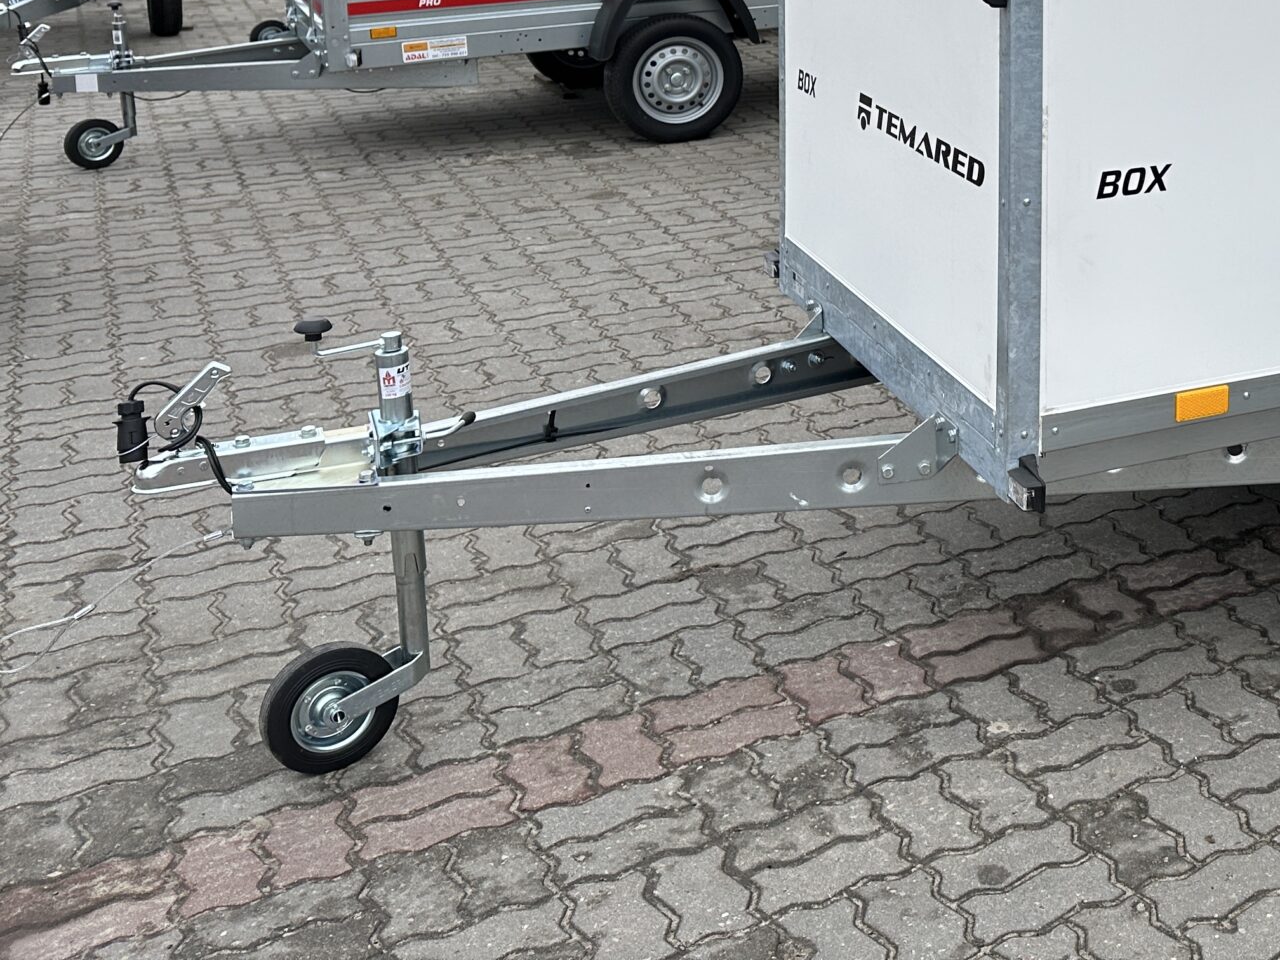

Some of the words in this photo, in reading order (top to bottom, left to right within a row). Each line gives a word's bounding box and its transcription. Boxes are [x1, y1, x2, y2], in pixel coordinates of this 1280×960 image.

[797, 68, 817, 98] BOX
[875, 104, 986, 187] TEMARED
[1096, 163, 1172, 200] BOX
